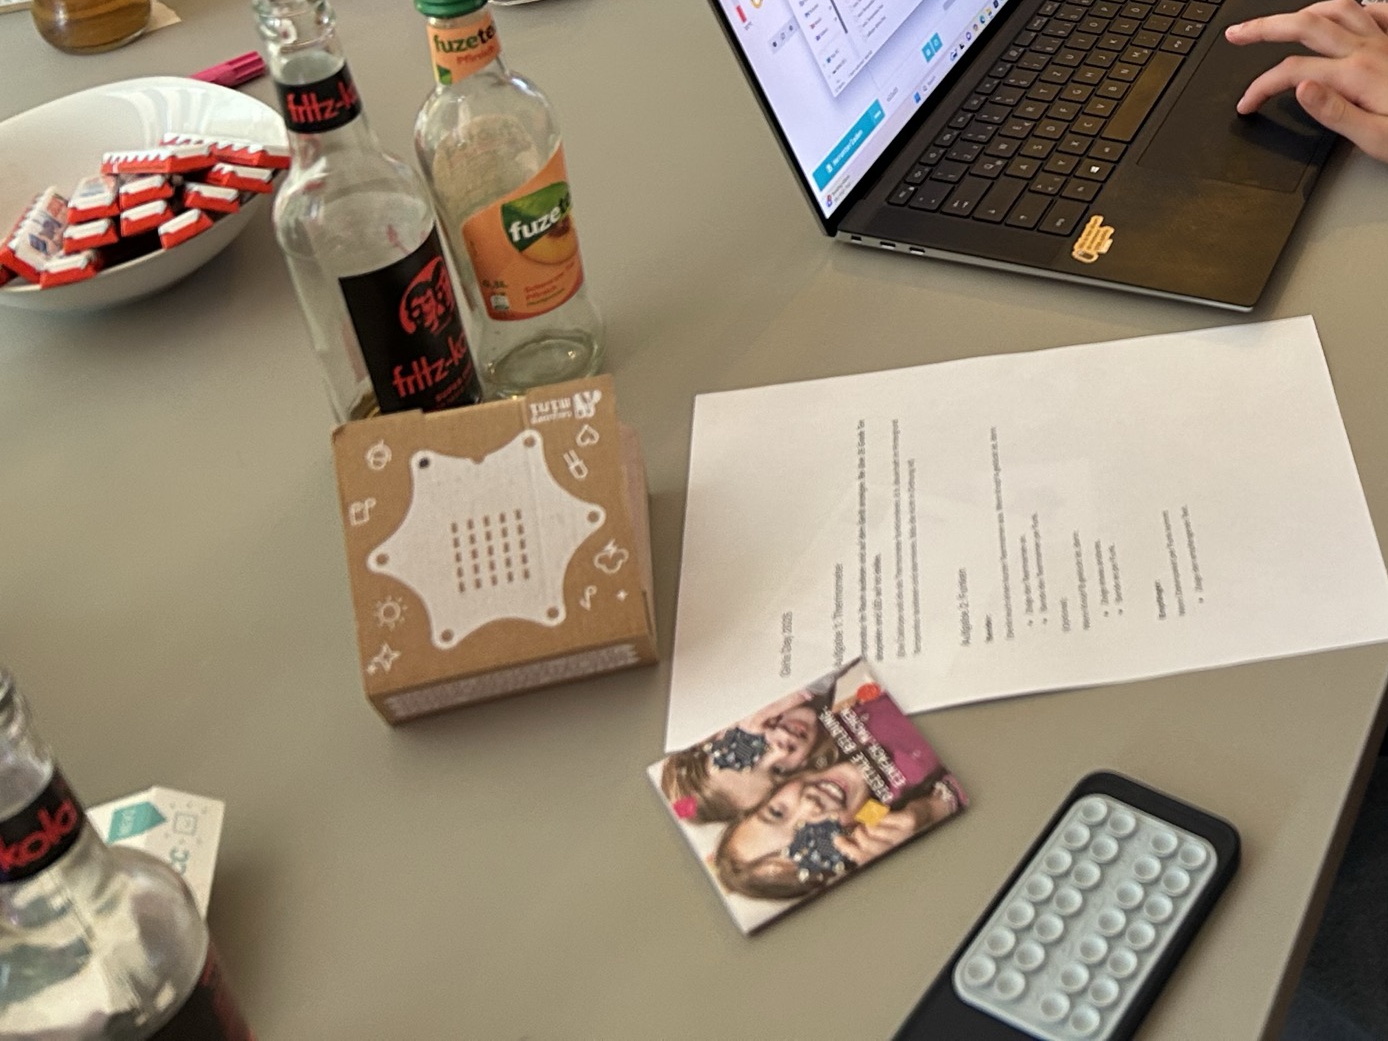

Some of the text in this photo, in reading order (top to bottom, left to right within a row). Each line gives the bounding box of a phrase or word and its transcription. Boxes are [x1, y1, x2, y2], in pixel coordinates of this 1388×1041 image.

[529, 397, 572, 417] mini
[832, 563, 844, 620] Thermometer
[781, 635, 794, 654] Day
[850, 750, 894, 803] DIGITALE
